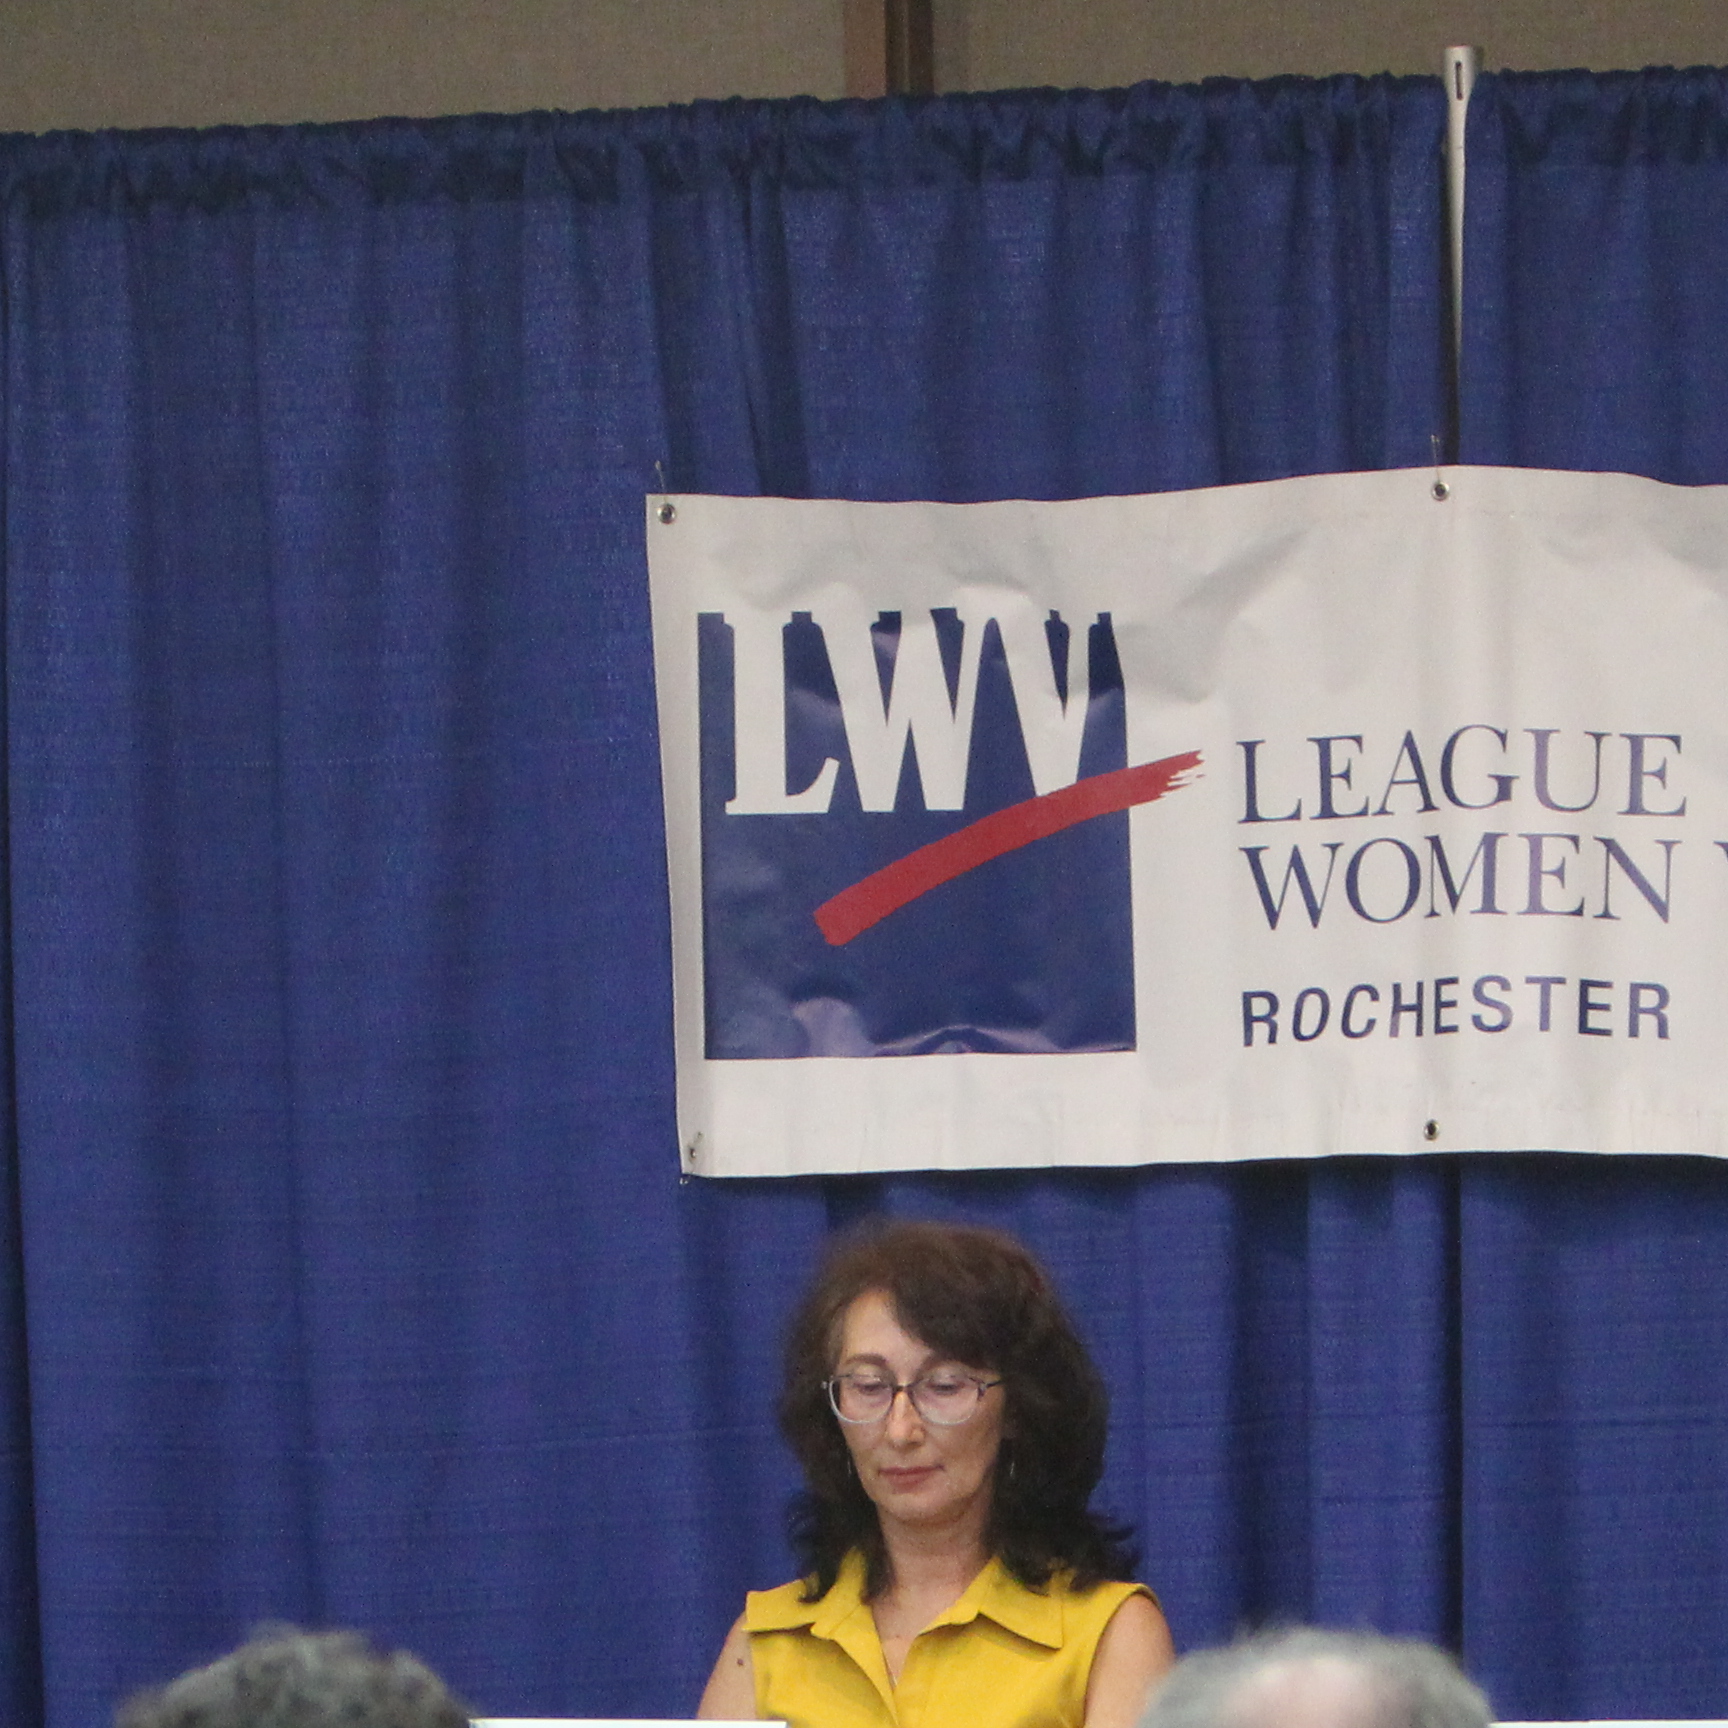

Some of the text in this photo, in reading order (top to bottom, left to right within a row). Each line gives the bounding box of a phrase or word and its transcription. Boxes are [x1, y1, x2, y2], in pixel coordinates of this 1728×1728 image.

[724, 606, 1106, 815] LWV
[1236, 724, 1688, 824] LEAGUE
[1238, 832, 1683, 931] WOMEN
[1241, 974, 1673, 1048] ROCHESTER
